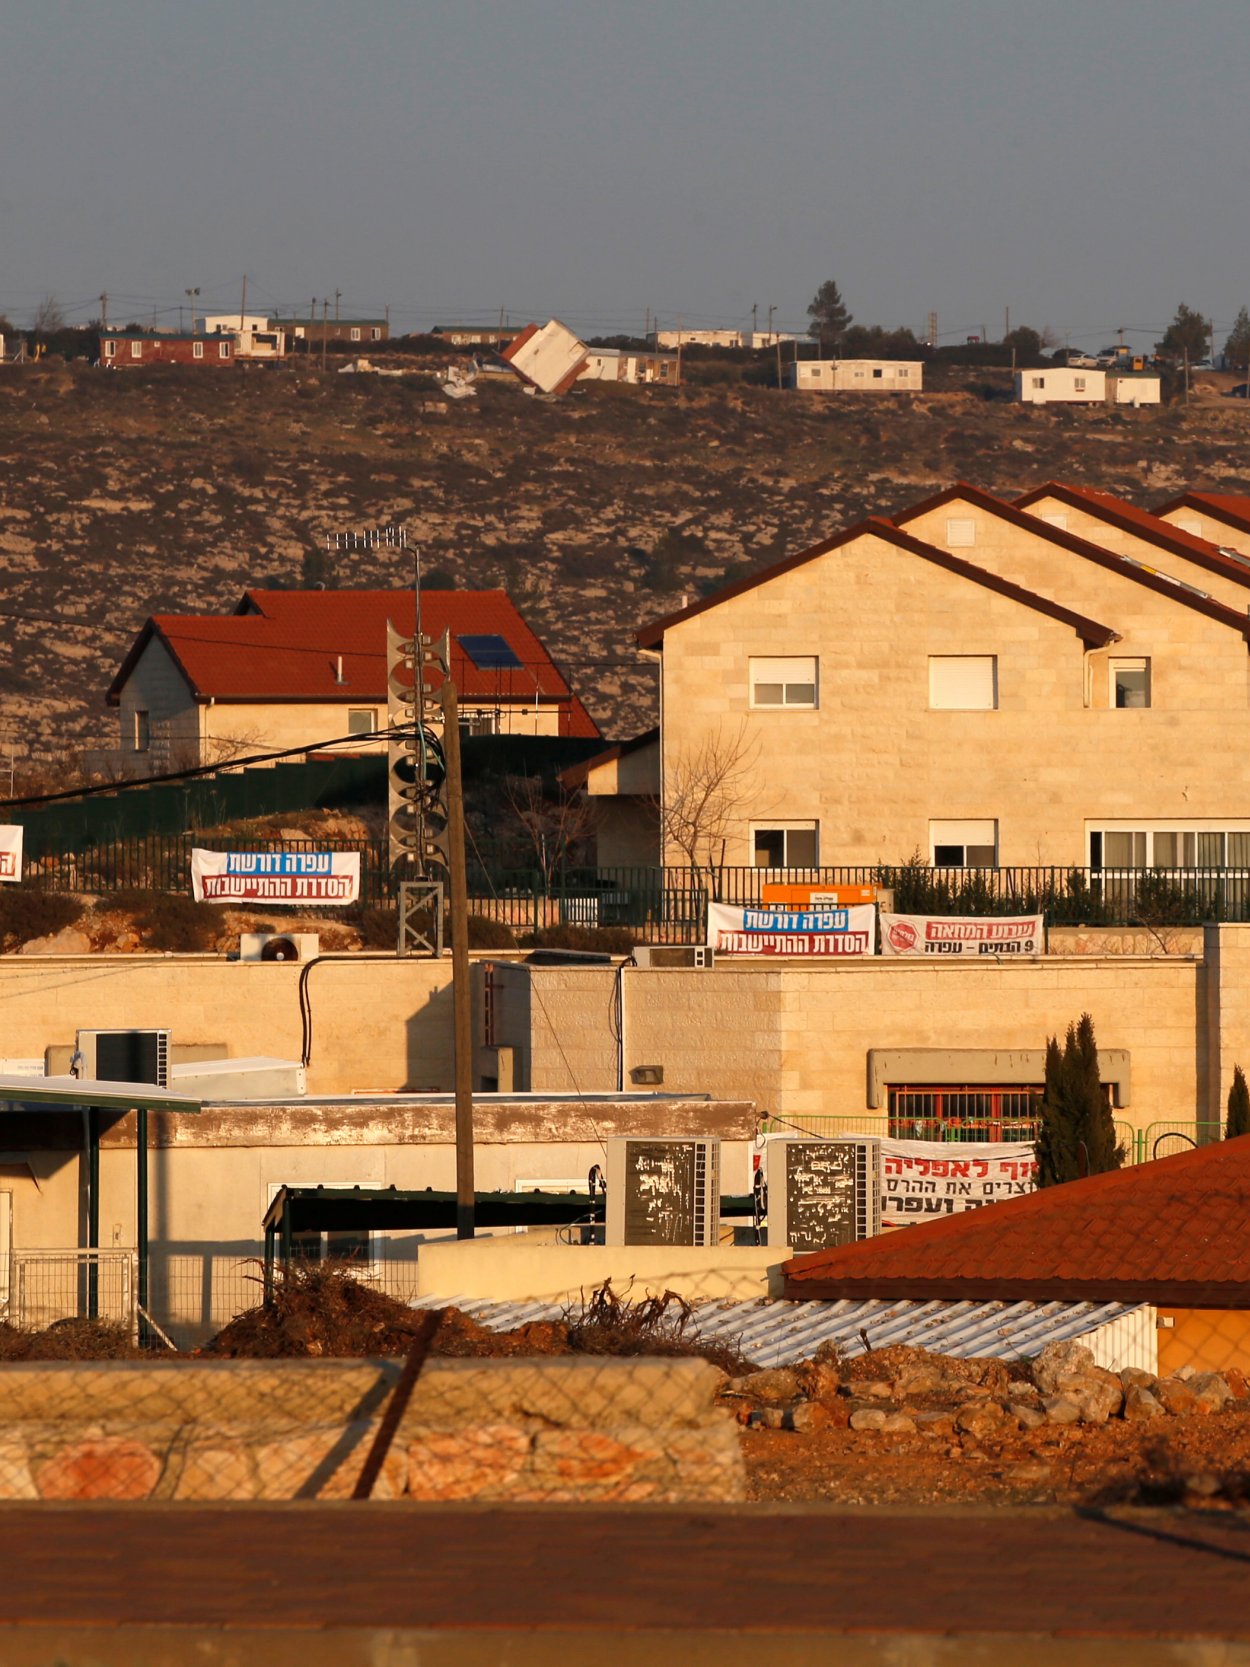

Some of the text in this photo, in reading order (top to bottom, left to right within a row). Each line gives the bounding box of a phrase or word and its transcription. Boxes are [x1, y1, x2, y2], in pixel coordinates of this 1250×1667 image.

[229, 853, 329, 873] עפרה דורשת
[205, 876, 351, 897] הסדרת ההתיישבות
[745, 911, 846, 930] עפרה דורשת
[930, 923, 1035, 939] שבוע המחאה
[720, 933, 868, 953] הסדרת ההתיישבות
[925, 941, 963, 954] עפרה
[1024, 940, 1034, 952] 9
[885, 1157, 989, 1178] לאפליה
[886, 1178, 1039, 1195] וצרים את ההרס
